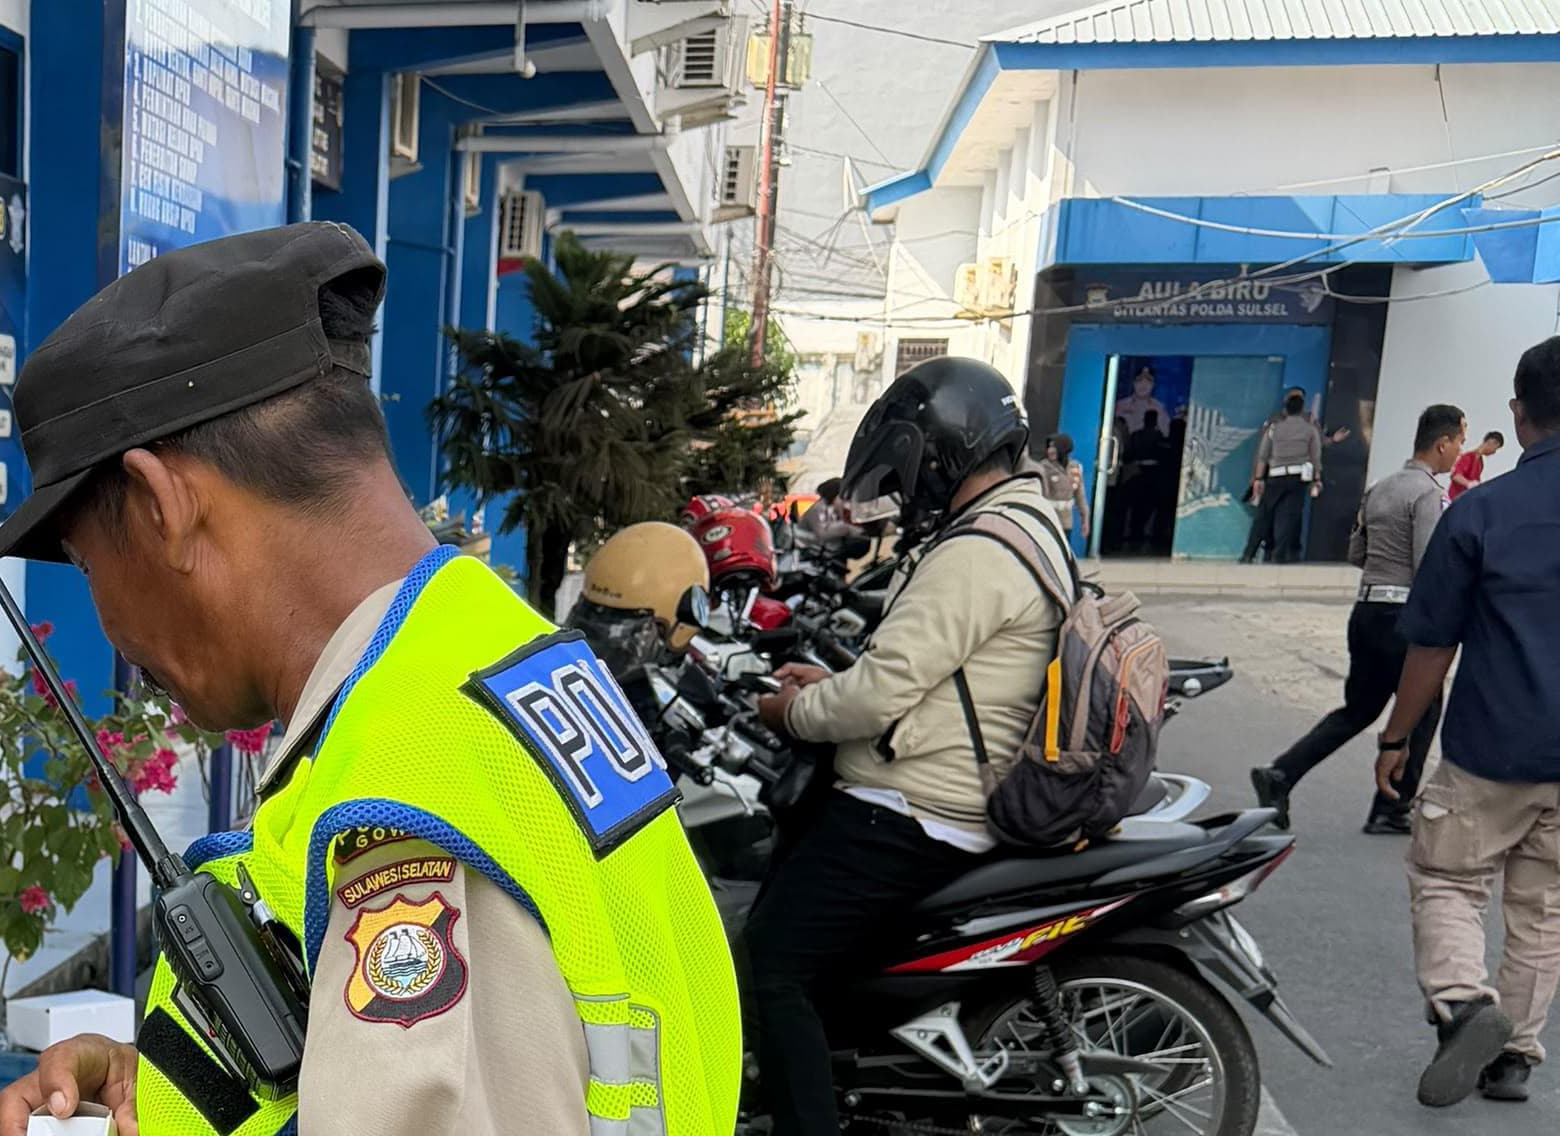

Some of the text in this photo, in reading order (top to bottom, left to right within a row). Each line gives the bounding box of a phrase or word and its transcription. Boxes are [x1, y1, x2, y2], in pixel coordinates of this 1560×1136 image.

[1114, 303, 1288, 317] DITLANTAS POLDA SULSEL
[505, 659, 668, 809] PO
[344, 861, 452, 903] SULAWESI SELATAN
